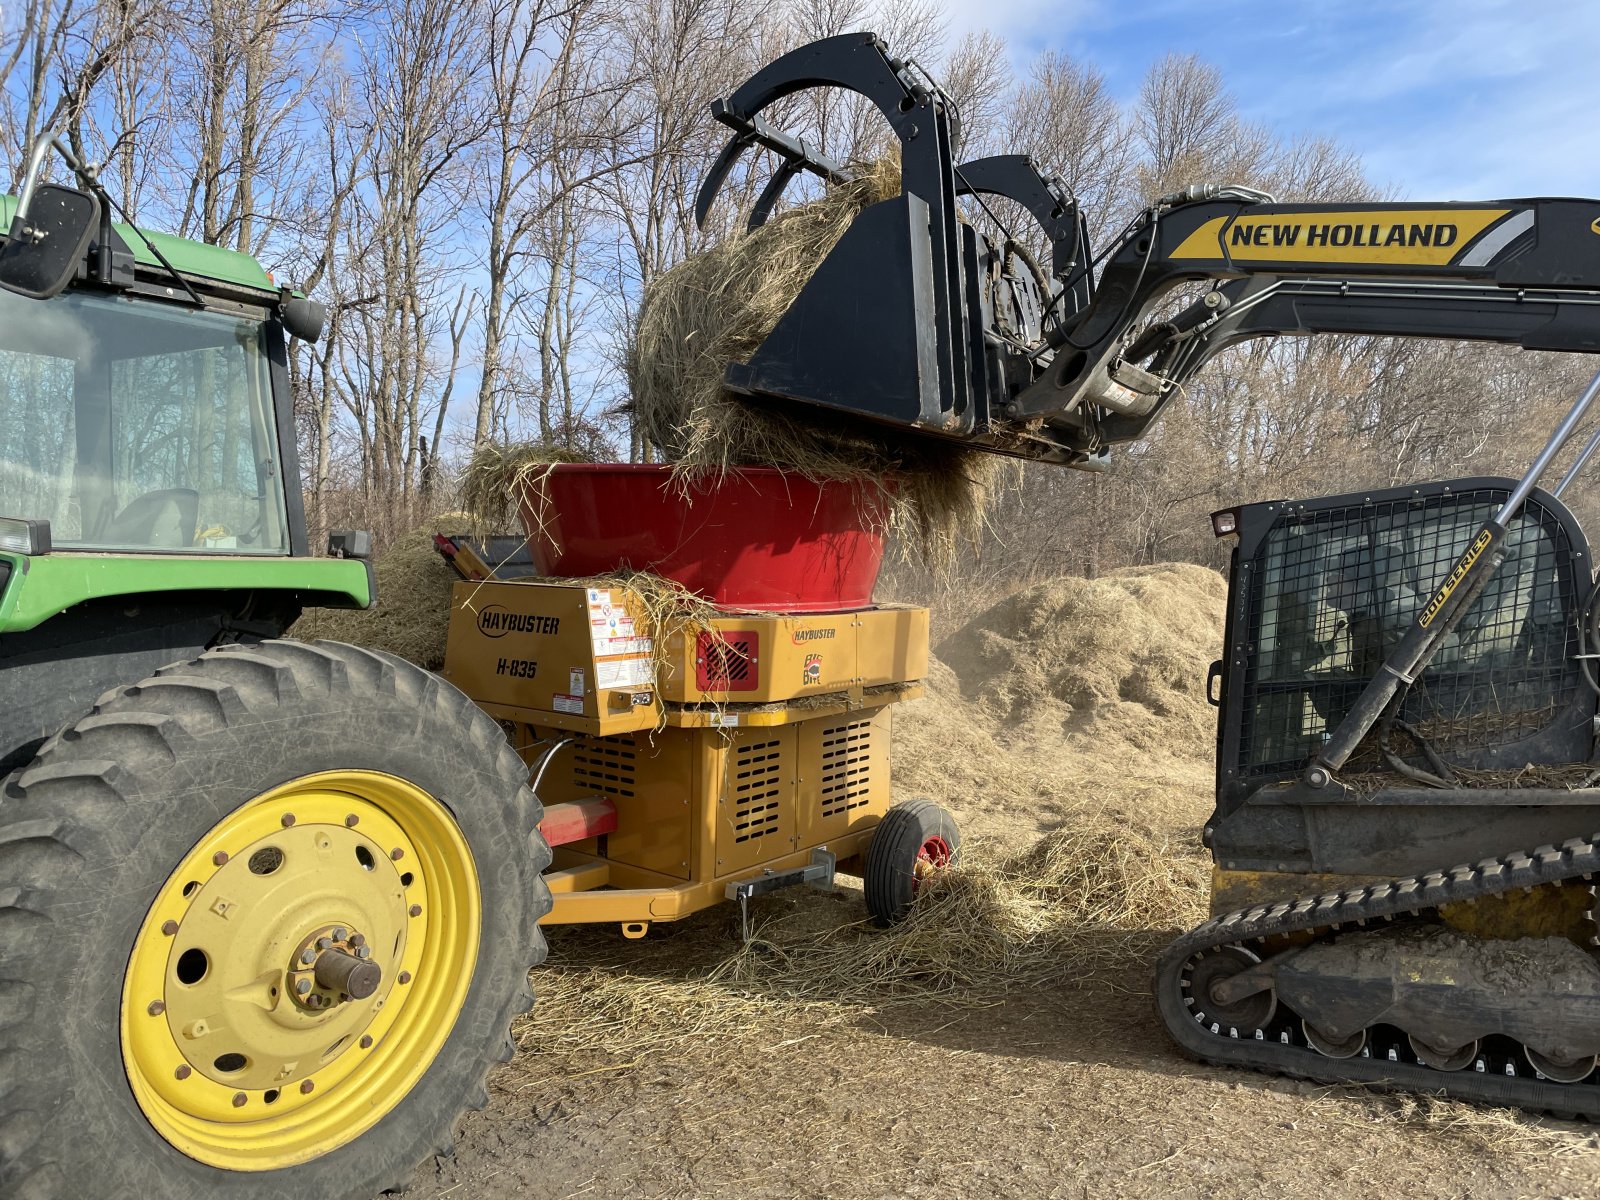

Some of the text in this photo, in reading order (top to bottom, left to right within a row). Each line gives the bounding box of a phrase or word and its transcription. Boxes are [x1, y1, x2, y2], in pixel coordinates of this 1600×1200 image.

[1231, 224, 1458, 247] NEW HOLLAND
[1419, 532, 1490, 626] 200 SERIES
[481, 611, 560, 635] HAYBUSTER
[794, 628, 836, 641] HAYBUSTER
[496, 657, 538, 679] H-835
[803, 653, 824, 668] BIG
[803, 669, 821, 686] BITE
